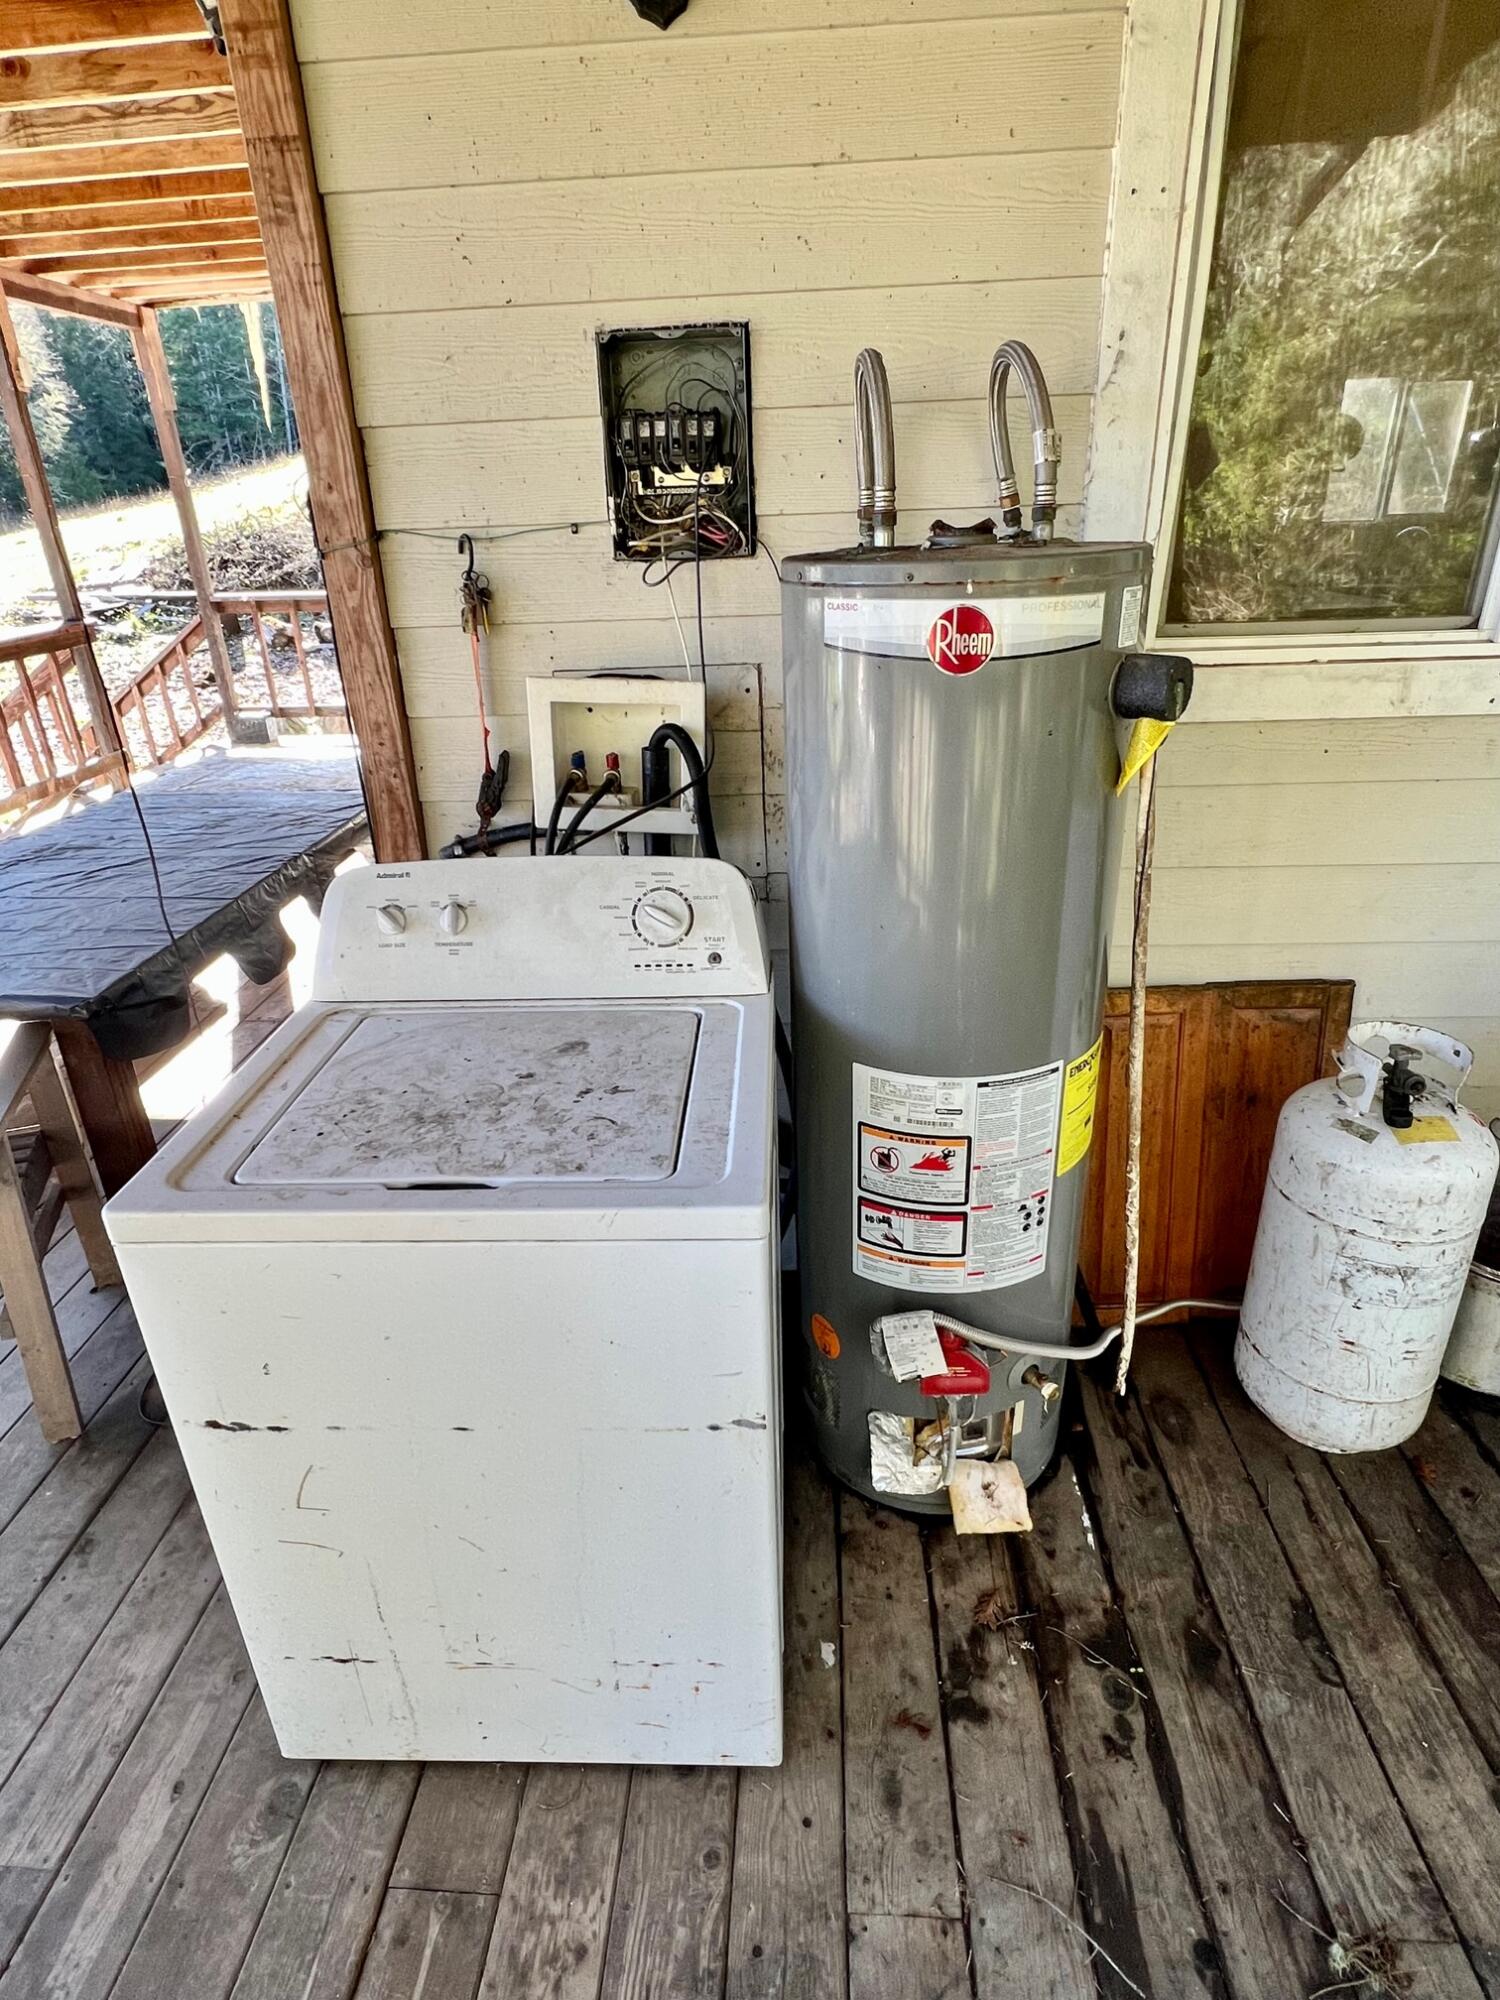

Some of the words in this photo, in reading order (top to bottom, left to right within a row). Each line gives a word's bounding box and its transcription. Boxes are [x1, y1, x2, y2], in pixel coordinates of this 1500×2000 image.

[827, 602, 859, 612] CLASSIC
[1020, 599, 1103, 613] PROFESSIONAL
[935, 607, 992, 665] Rheem
[897, 1136, 937, 1146] WARNING
[898, 1210, 932, 1220] DANGER
